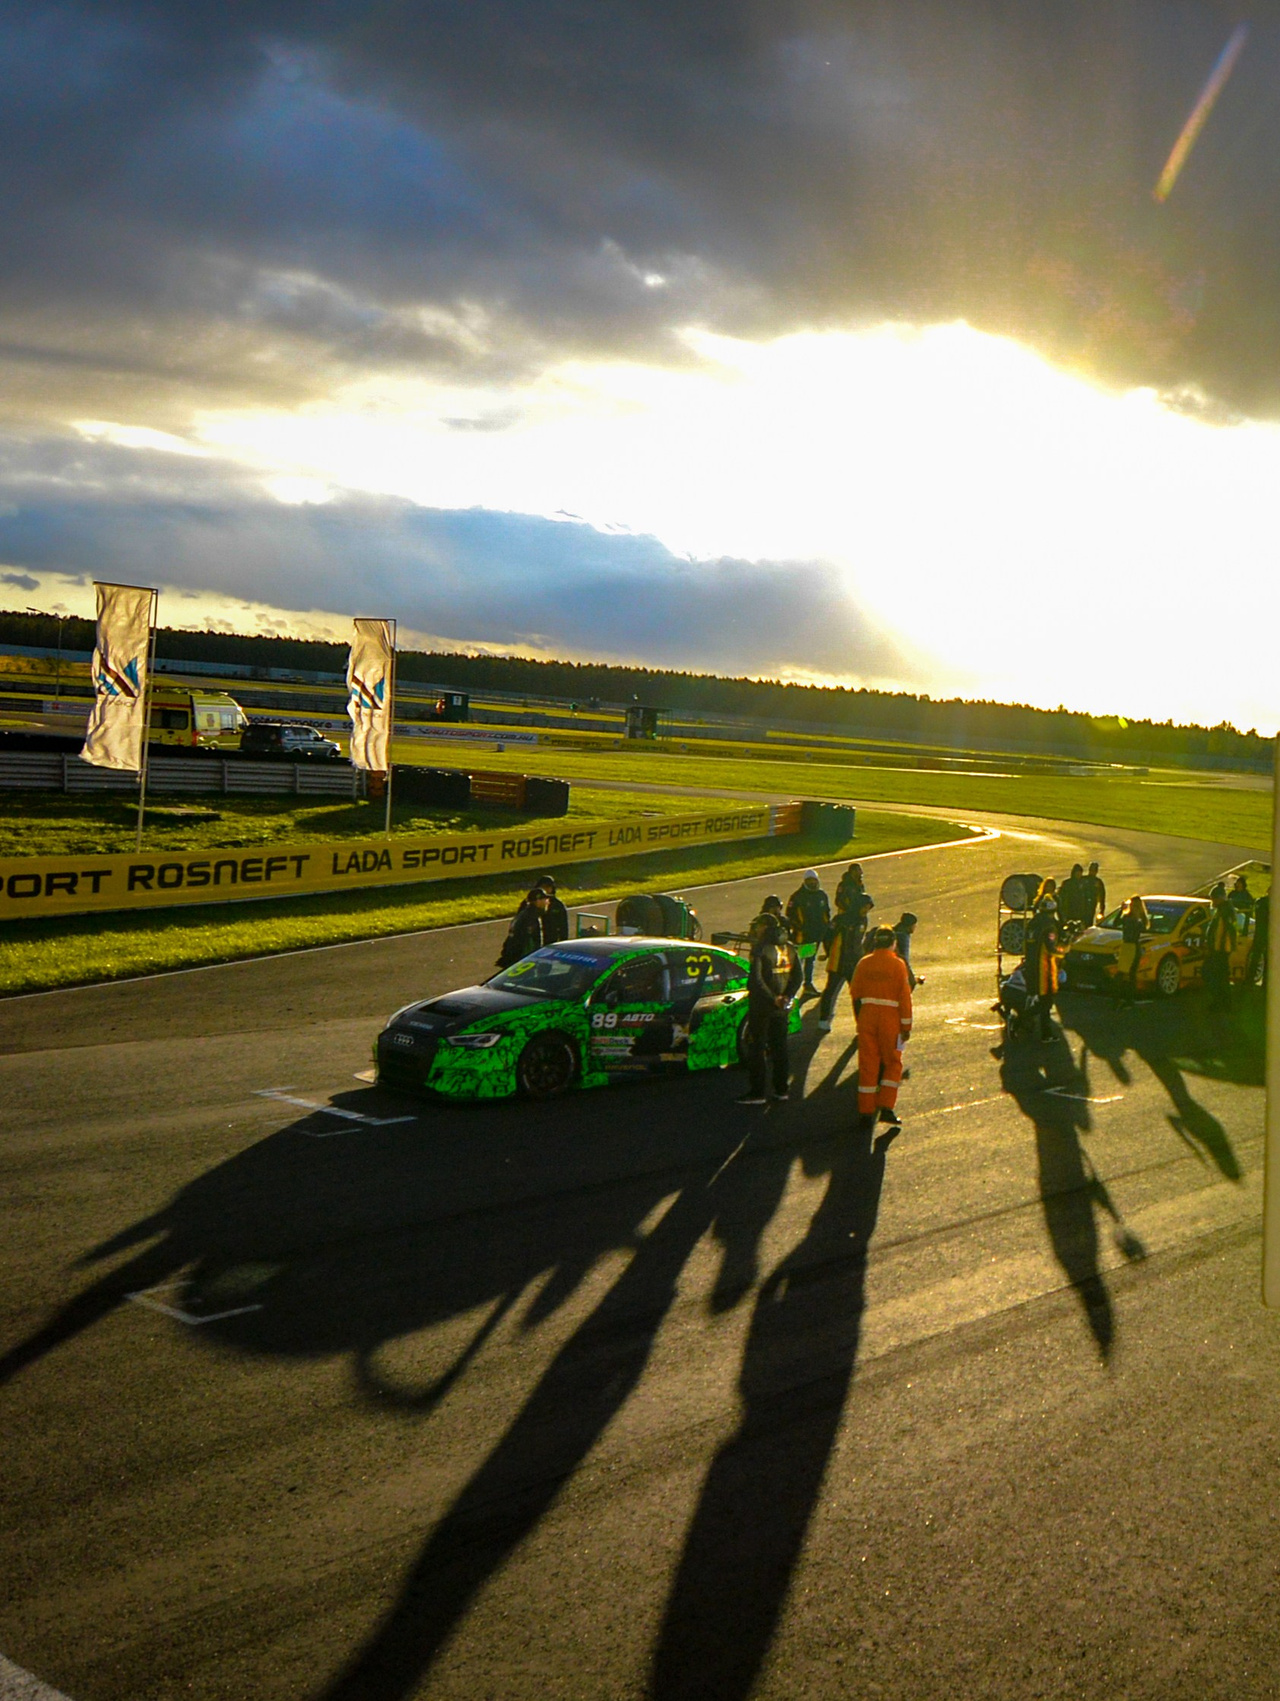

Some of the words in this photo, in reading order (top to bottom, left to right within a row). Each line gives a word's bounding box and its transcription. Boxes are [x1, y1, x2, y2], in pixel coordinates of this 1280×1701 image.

[0, 869, 112, 899] ORT
[127, 854, 310, 891] ROSNEFT
[332, 849, 392, 875] LADA
[402, 843, 494, 869] SPORT
[501, 831, 597, 860] ROSNEFT
[609, 825, 643, 847] LADA
[647, 821, 702, 841] SPORT
[704, 812, 765, 834] ROSNEFT
[591, 1013, 618, 1029] 89
